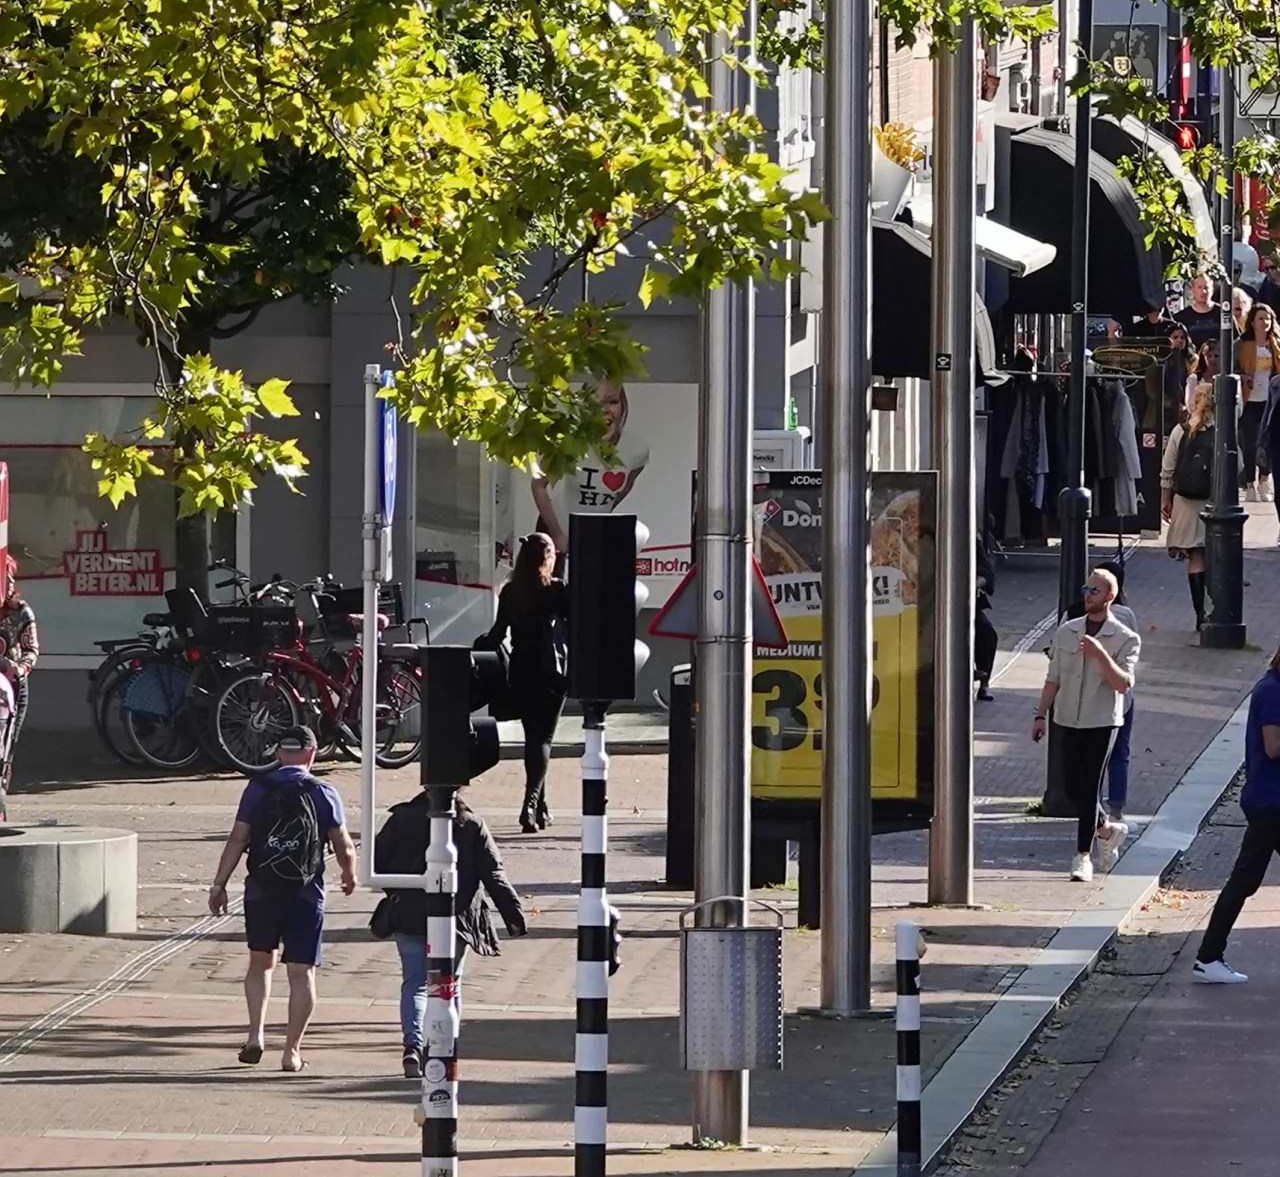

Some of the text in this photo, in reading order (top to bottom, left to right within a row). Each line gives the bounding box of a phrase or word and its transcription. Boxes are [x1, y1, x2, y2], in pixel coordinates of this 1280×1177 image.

[579, 467, 599, 490] I
[789, 475, 822, 486] JCDec
[782, 510, 822, 527] Don
[78, 533, 102, 552] JIJ
[65, 551, 157, 574] VERDIENT
[74, 573, 160, 593] BETER.NL
[756, 644, 818, 657] MEDIUM
